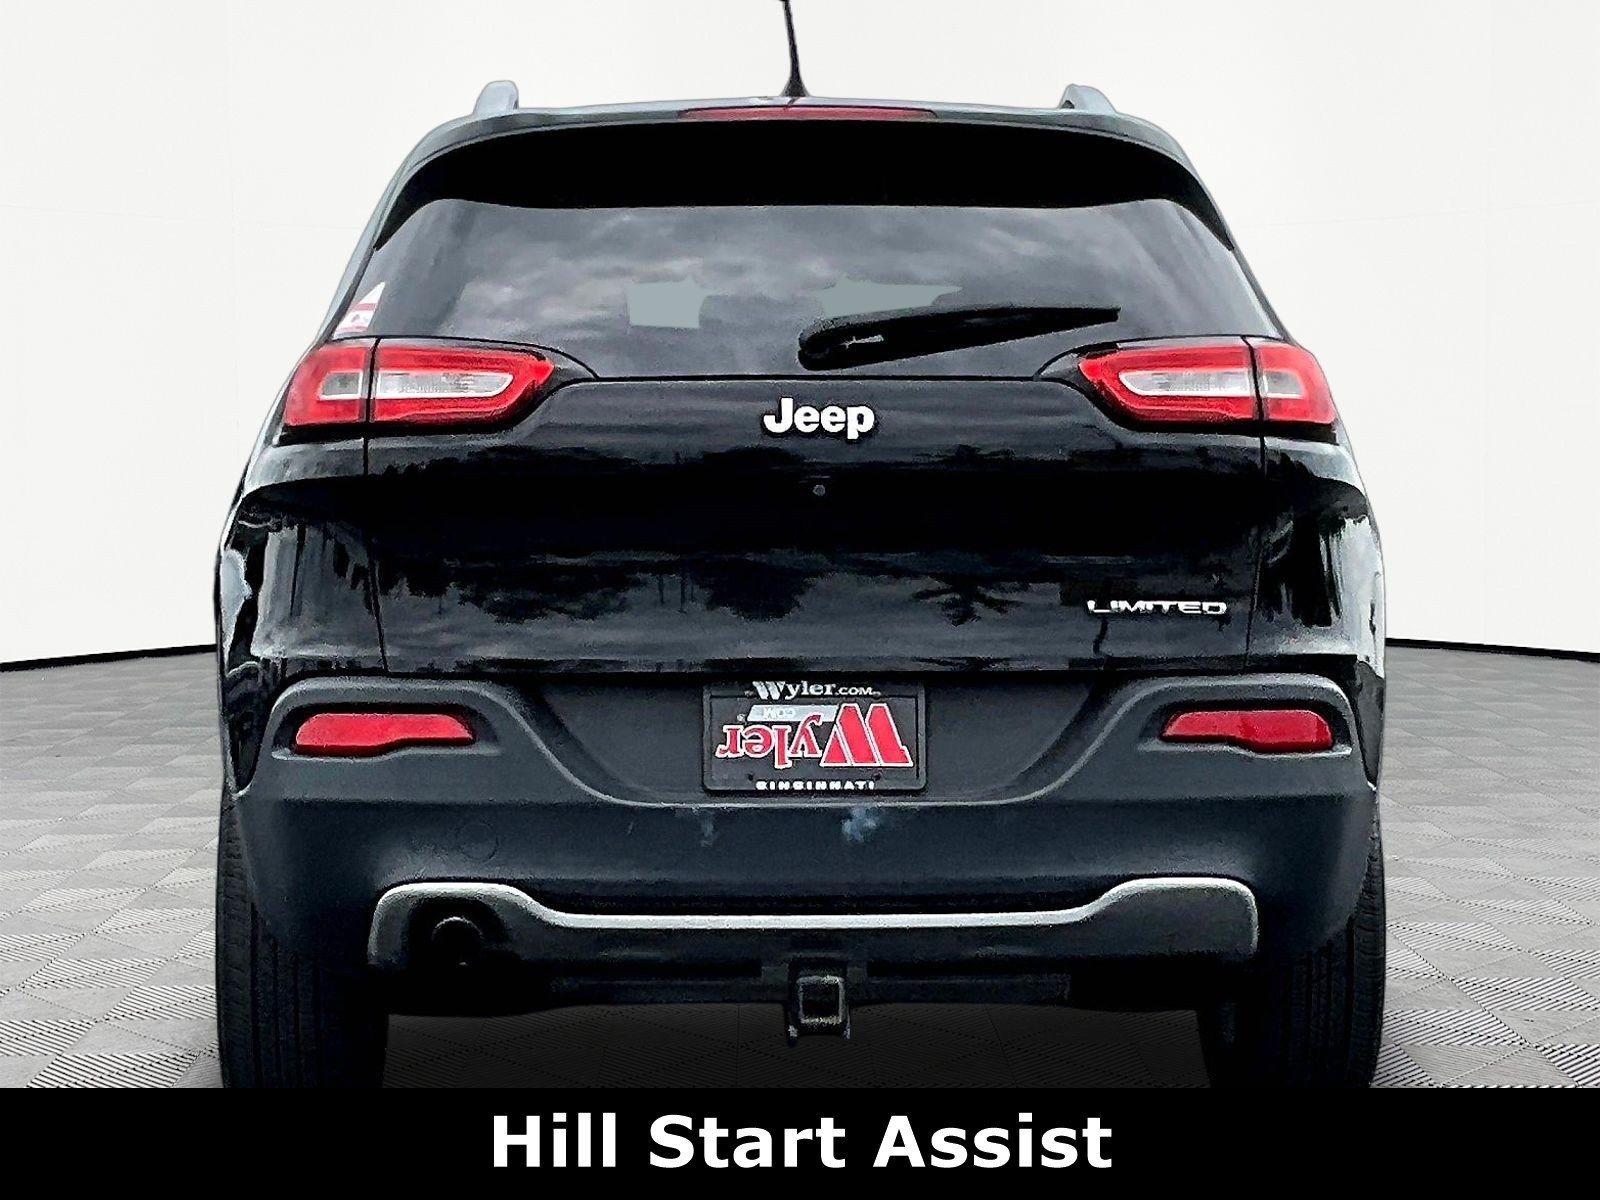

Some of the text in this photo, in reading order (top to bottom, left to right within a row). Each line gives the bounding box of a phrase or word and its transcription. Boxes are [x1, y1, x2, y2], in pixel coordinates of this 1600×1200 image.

[763, 397, 875, 440] Jeep
[1087, 600, 1227, 614] LIMITED
[715, 703, 914, 769] Wyler
[756, 780, 875, 791] CINCINNATI
